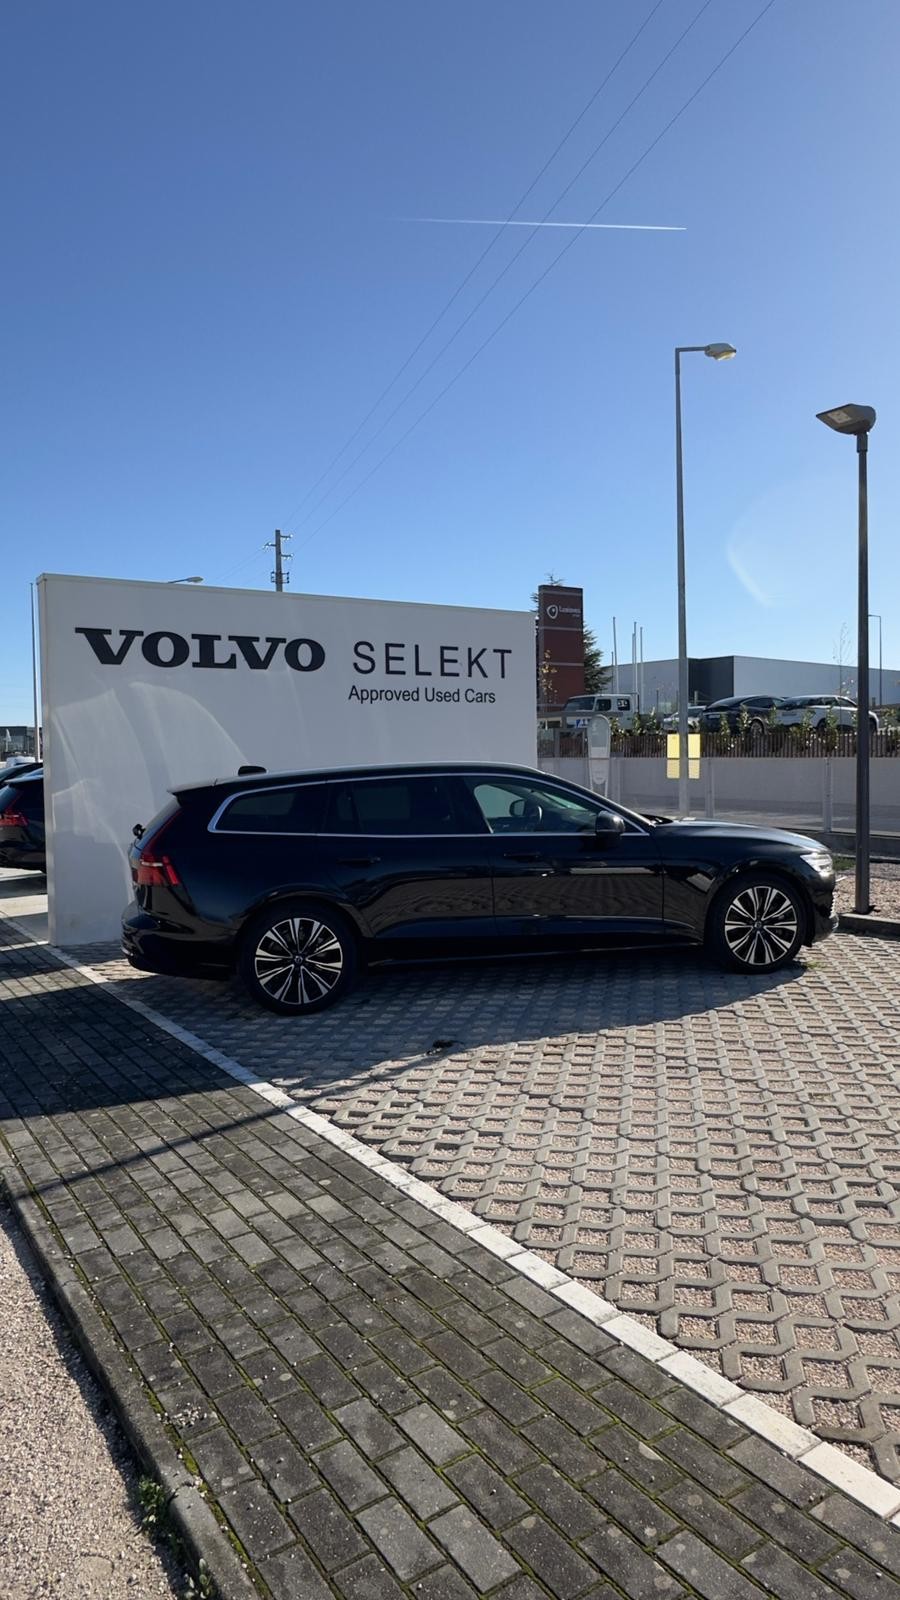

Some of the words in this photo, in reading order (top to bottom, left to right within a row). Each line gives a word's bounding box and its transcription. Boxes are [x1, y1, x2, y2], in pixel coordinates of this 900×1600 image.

[75, 627, 325, 672] VOLVO
[353, 641, 512, 679] SELEKT
[348, 685, 420, 705] Approved
[425, 687, 461, 703] Used
[464, 689, 496, 704] Cars
